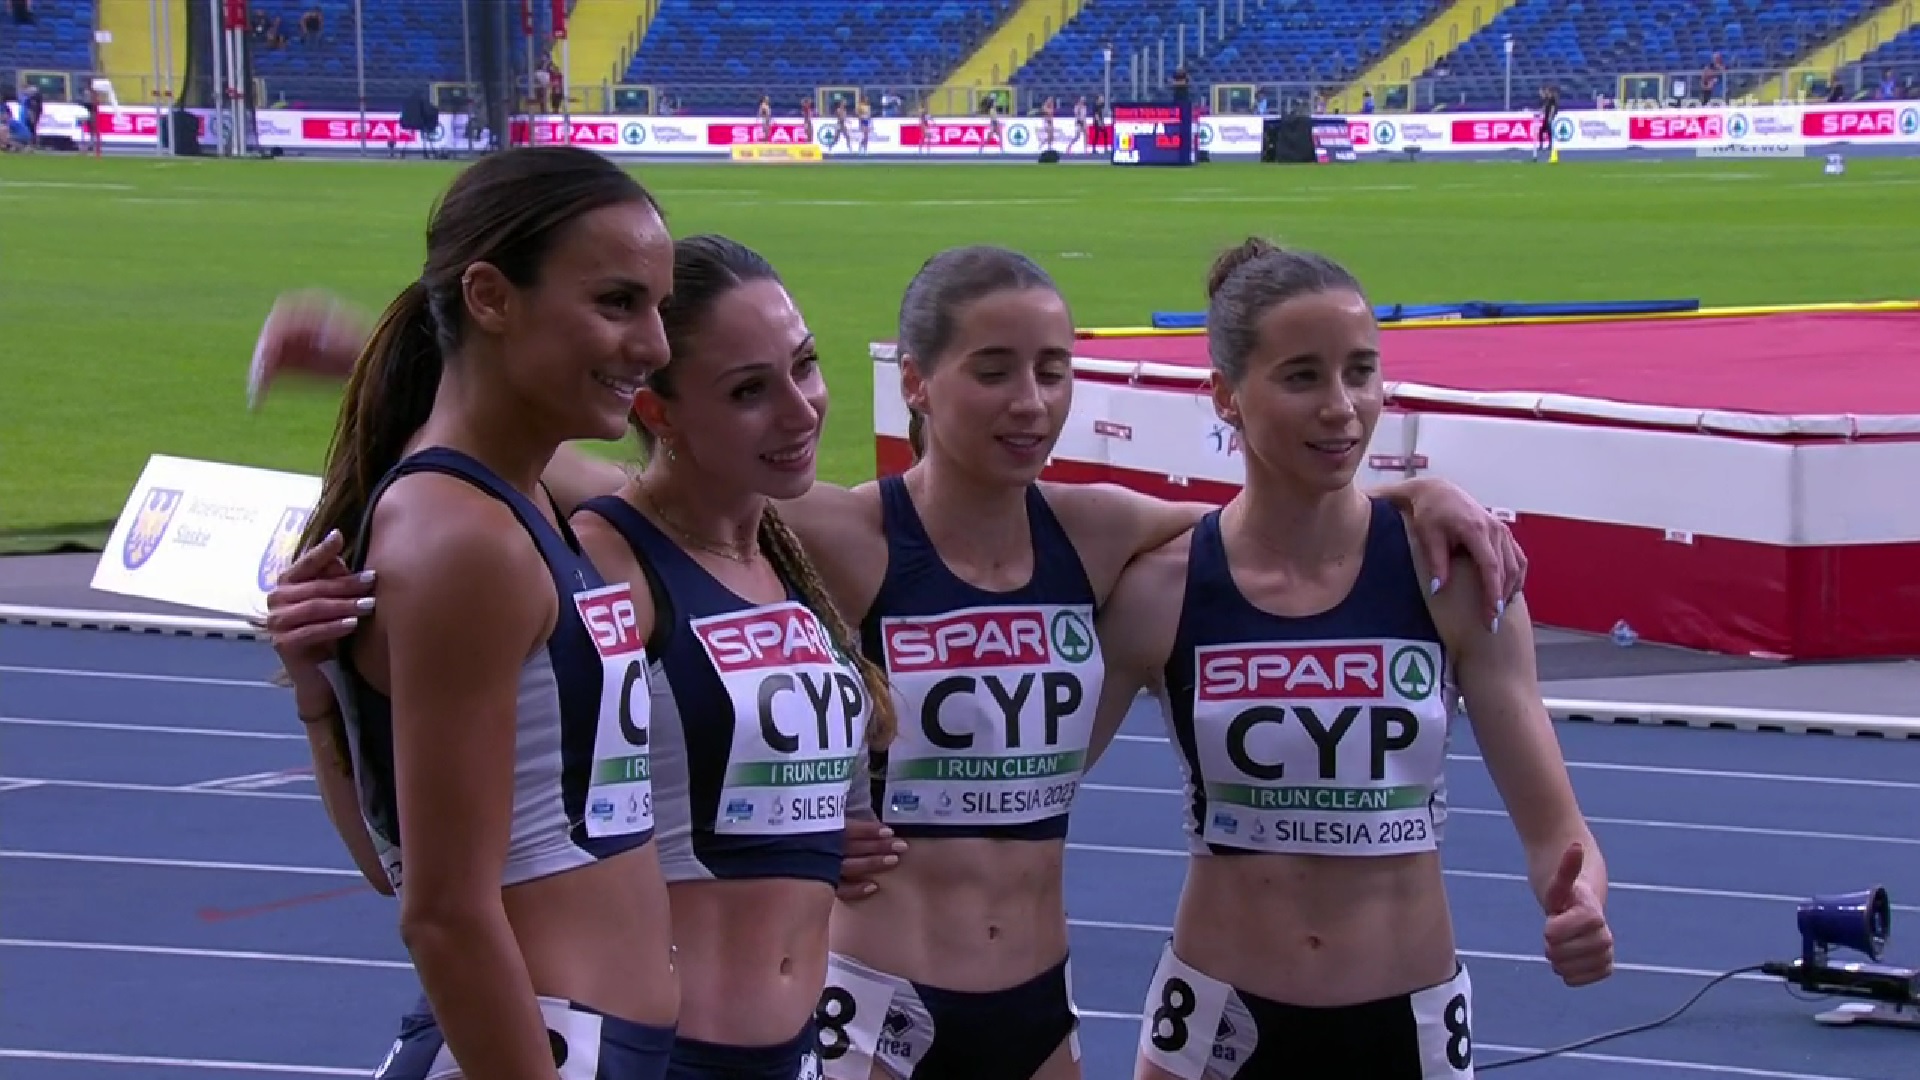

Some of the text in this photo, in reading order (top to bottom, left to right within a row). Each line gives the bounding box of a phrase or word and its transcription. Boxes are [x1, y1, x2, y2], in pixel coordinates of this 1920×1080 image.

[534, 125, 617, 142] SPAR
[1650, 119, 1721, 137] SPAR
[1822, 113, 1892, 133] SPAR
[586, 599, 640, 647] SP
[708, 616, 827, 664] SPAR
[891, 618, 1045, 664] SPAR
[1203, 653, 1379, 694] SPAR
[757, 672, 863, 753] CYP
[921, 671, 1083, 749] CYP
[1226, 705, 1420, 781] CYP
[771, 759, 850, 784] I RUN CLEA
[937, 756, 1058, 779] I RUN CLEAN
[962, 788, 1041, 814] SILESIA
[1251, 788, 1388, 808] I RUN CLEAN
[1275, 819, 1427, 844] SILESIA 2023
[816, 986, 857, 1060] 8
[1152, 977, 1196, 1052] 8
[1443, 993, 1472, 1071] 8
[876, 1037, 911, 1058] rrea
